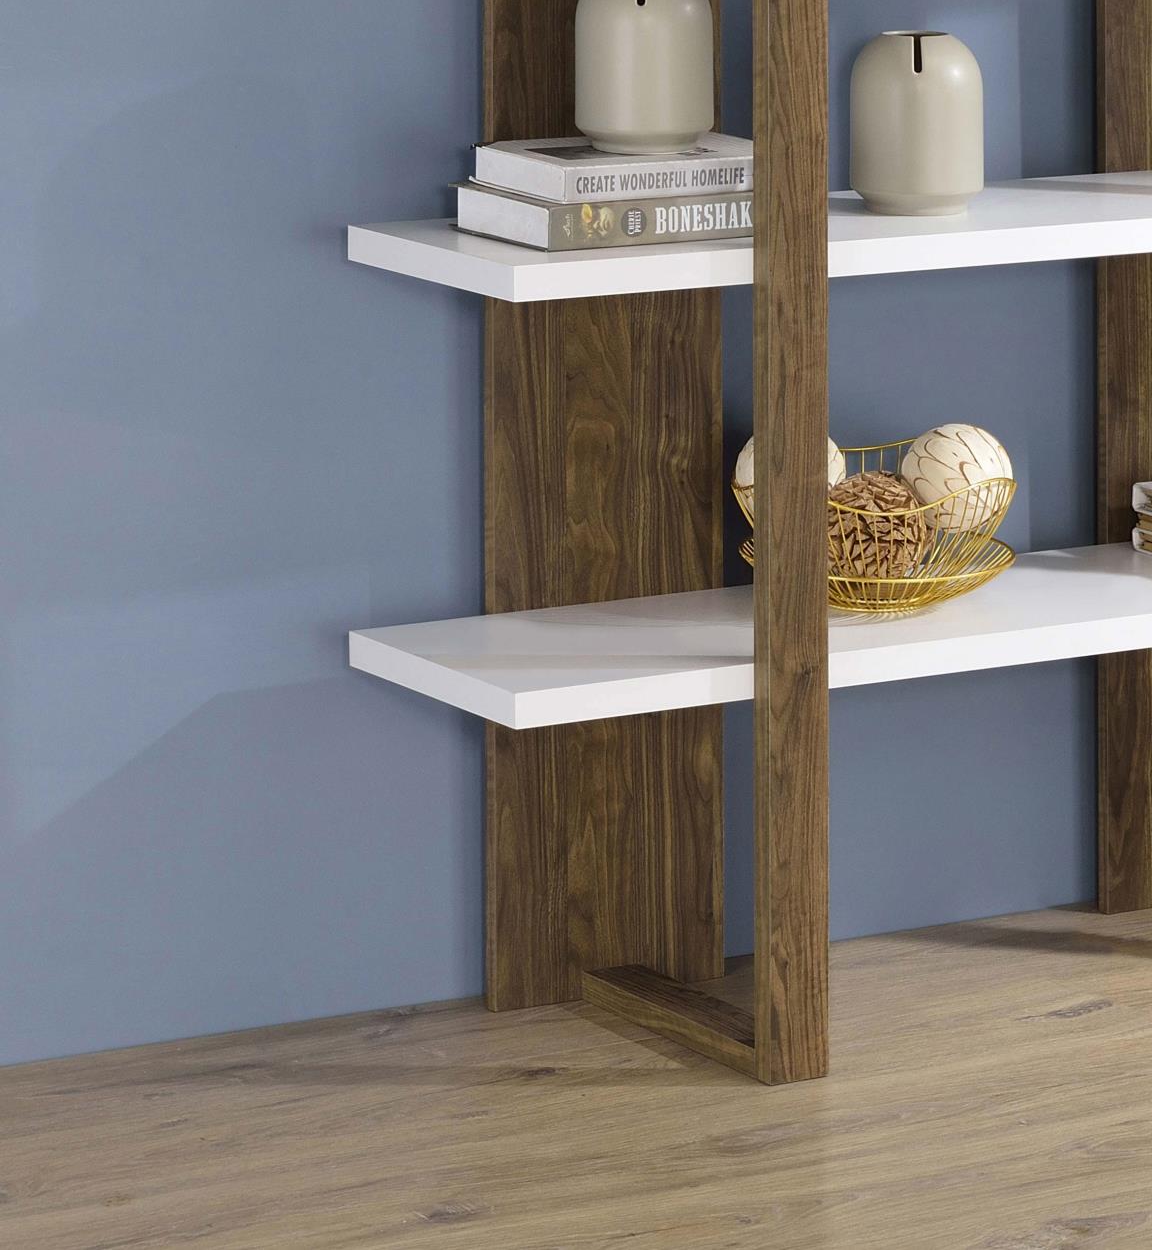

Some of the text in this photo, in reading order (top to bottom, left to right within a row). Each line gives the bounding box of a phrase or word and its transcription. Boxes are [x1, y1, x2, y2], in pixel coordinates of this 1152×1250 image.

[576, 167, 745, 194] CREATE WONDERFUL HOMELIFE
[655, 201, 753, 234] BONESHAK
